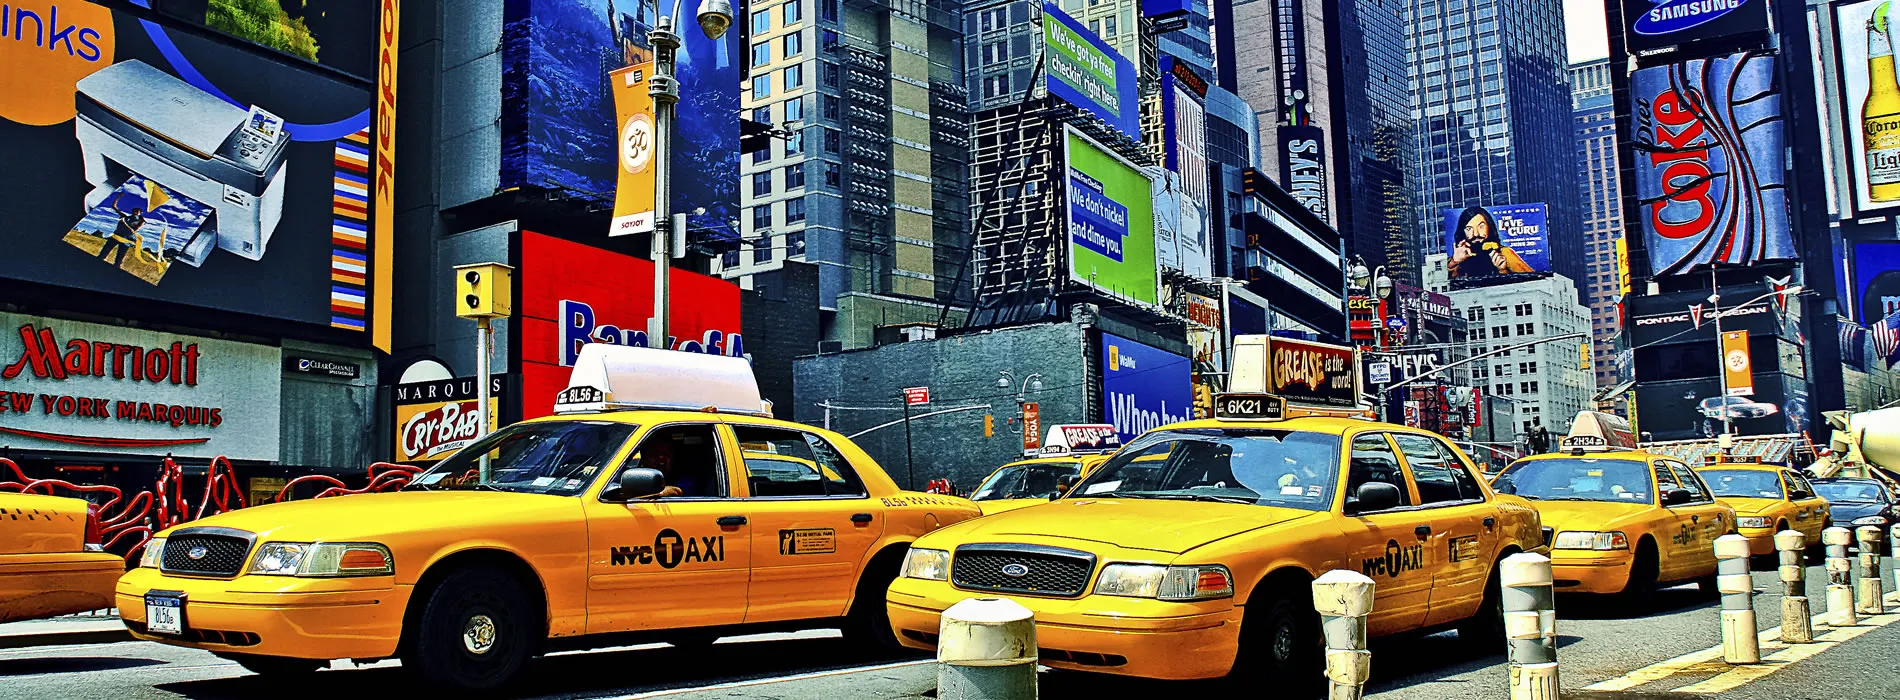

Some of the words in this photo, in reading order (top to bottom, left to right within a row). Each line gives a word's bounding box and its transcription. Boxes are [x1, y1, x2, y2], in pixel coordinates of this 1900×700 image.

[1649, 0, 1739, 22] SAMSUNG
[1049, 20, 1076, 53] We've
[1076, 45, 1089, 62] got
[1089, 53, 1098, 70] ya
[1098, 55, 1113, 79] free
[1052, 54, 1083, 86] checkin'
[1083, 75, 1101, 99] right
[1101, 88, 1119, 111] here.
[375, 0, 398, 207] odak
[1635, 97, 1655, 157] Diet
[1865, 120, 1900, 137] Coro
[1287, 139, 1322, 217] SHEY'S
[1070, 185, 1085, 207] We
[1085, 193, 1104, 217] don't
[1104, 203, 1125, 227] nickel
[621, 219, 645, 229] SOYJOY
[1072, 221, 1087, 239] and
[1087, 224, 1105, 247] dime
[1105, 236, 1121, 255] you.
[559, 299, 676, 366] Ban
[1636, 314, 1690, 326] PONTIAC
[2, 323, 200, 386] Marriott
[1273, 347, 1325, 391] GREASE
[1325, 353, 1332, 373] is
[1332, 353, 1344, 372] the
[1381, 353, 1438, 380] HEY'S
[397, 378, 501, 400] MARQUS
[570, 388, 591, 402] 8L56
[1331, 370, 1352, 389] word!
[0, 391, 35, 413] EW
[40, 394, 110, 418] YORK
[116, 400, 223, 427] MARQUIS
[1227, 400, 1261, 414] 6K21
[402, 402, 479, 457] CRY-BAB
[1029, 418, 1038, 443] YOGA
[1065, 428, 1101, 448] GREASE
[1573, 437, 1595, 446] 2H34
[610, 546, 653, 566] NYC
[656, 532, 724, 566] TAXI
[1362, 556, 1386, 577] NYC
[1387, 542, 1423, 576] TAXI
